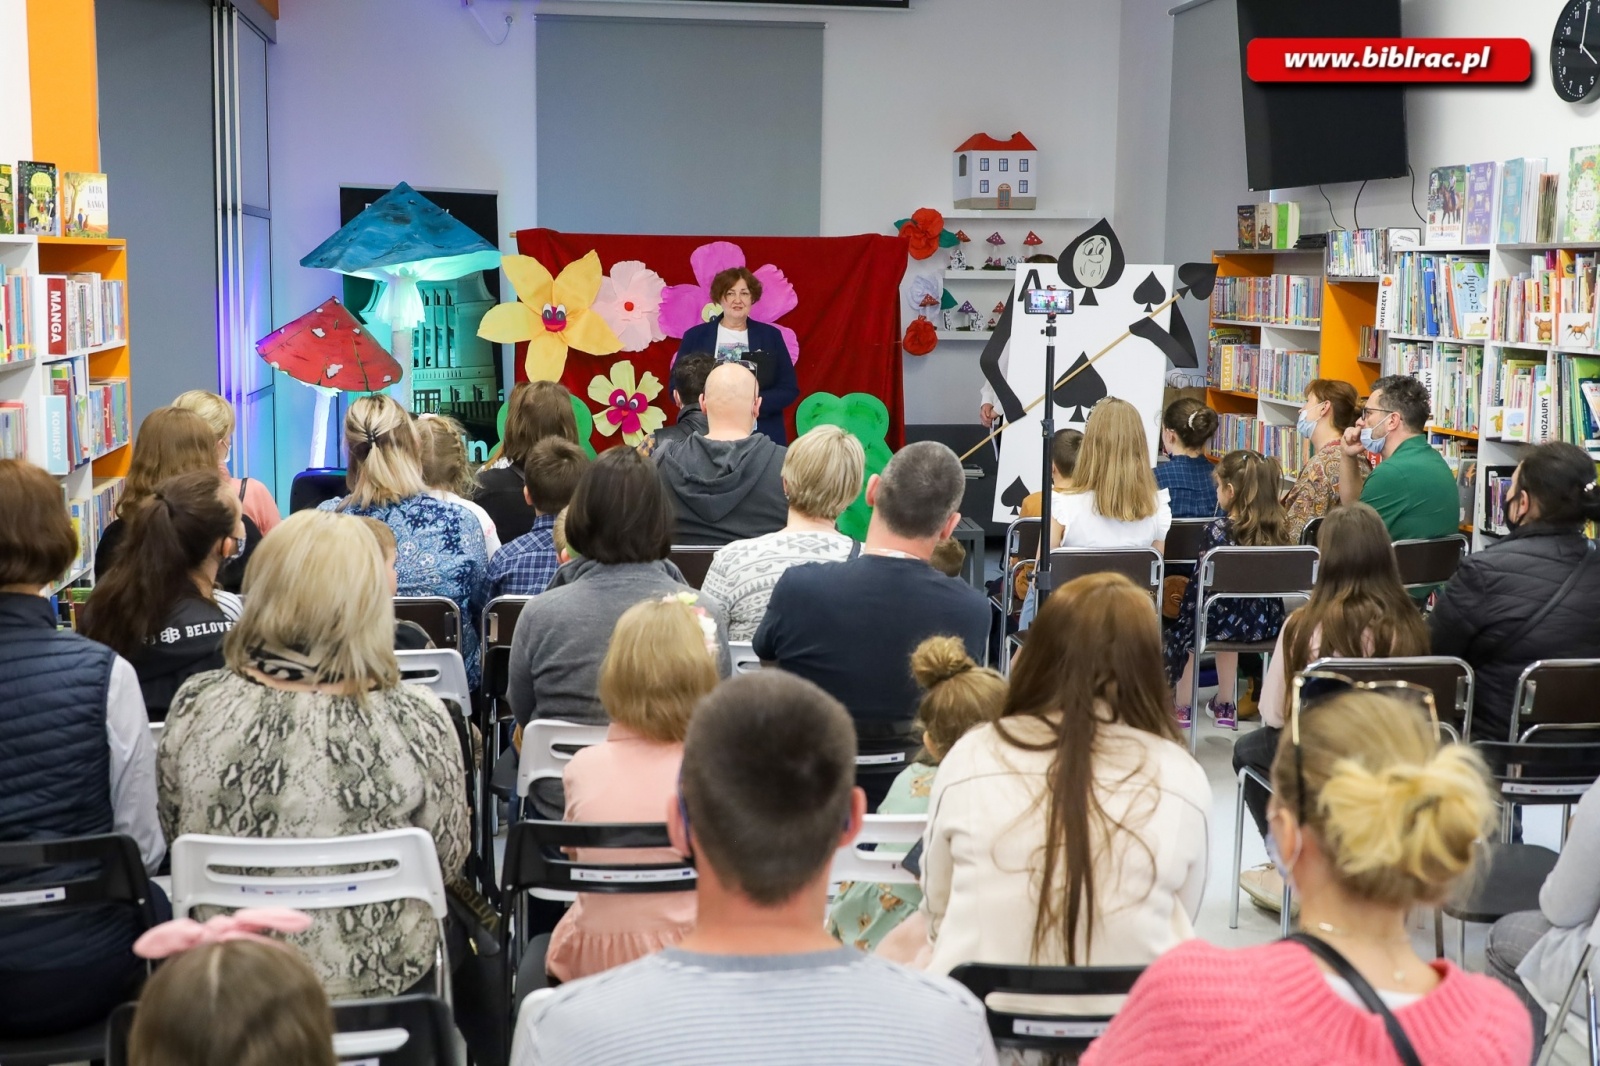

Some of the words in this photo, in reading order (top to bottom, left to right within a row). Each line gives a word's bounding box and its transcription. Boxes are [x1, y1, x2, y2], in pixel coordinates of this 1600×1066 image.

[50, 290, 62, 343] MANGA
[1380, 290, 1388, 328] ZWIERZĘTA
[51, 411, 61, 460] KOMIKSY
[185, 621, 237, 638] BELOVE
